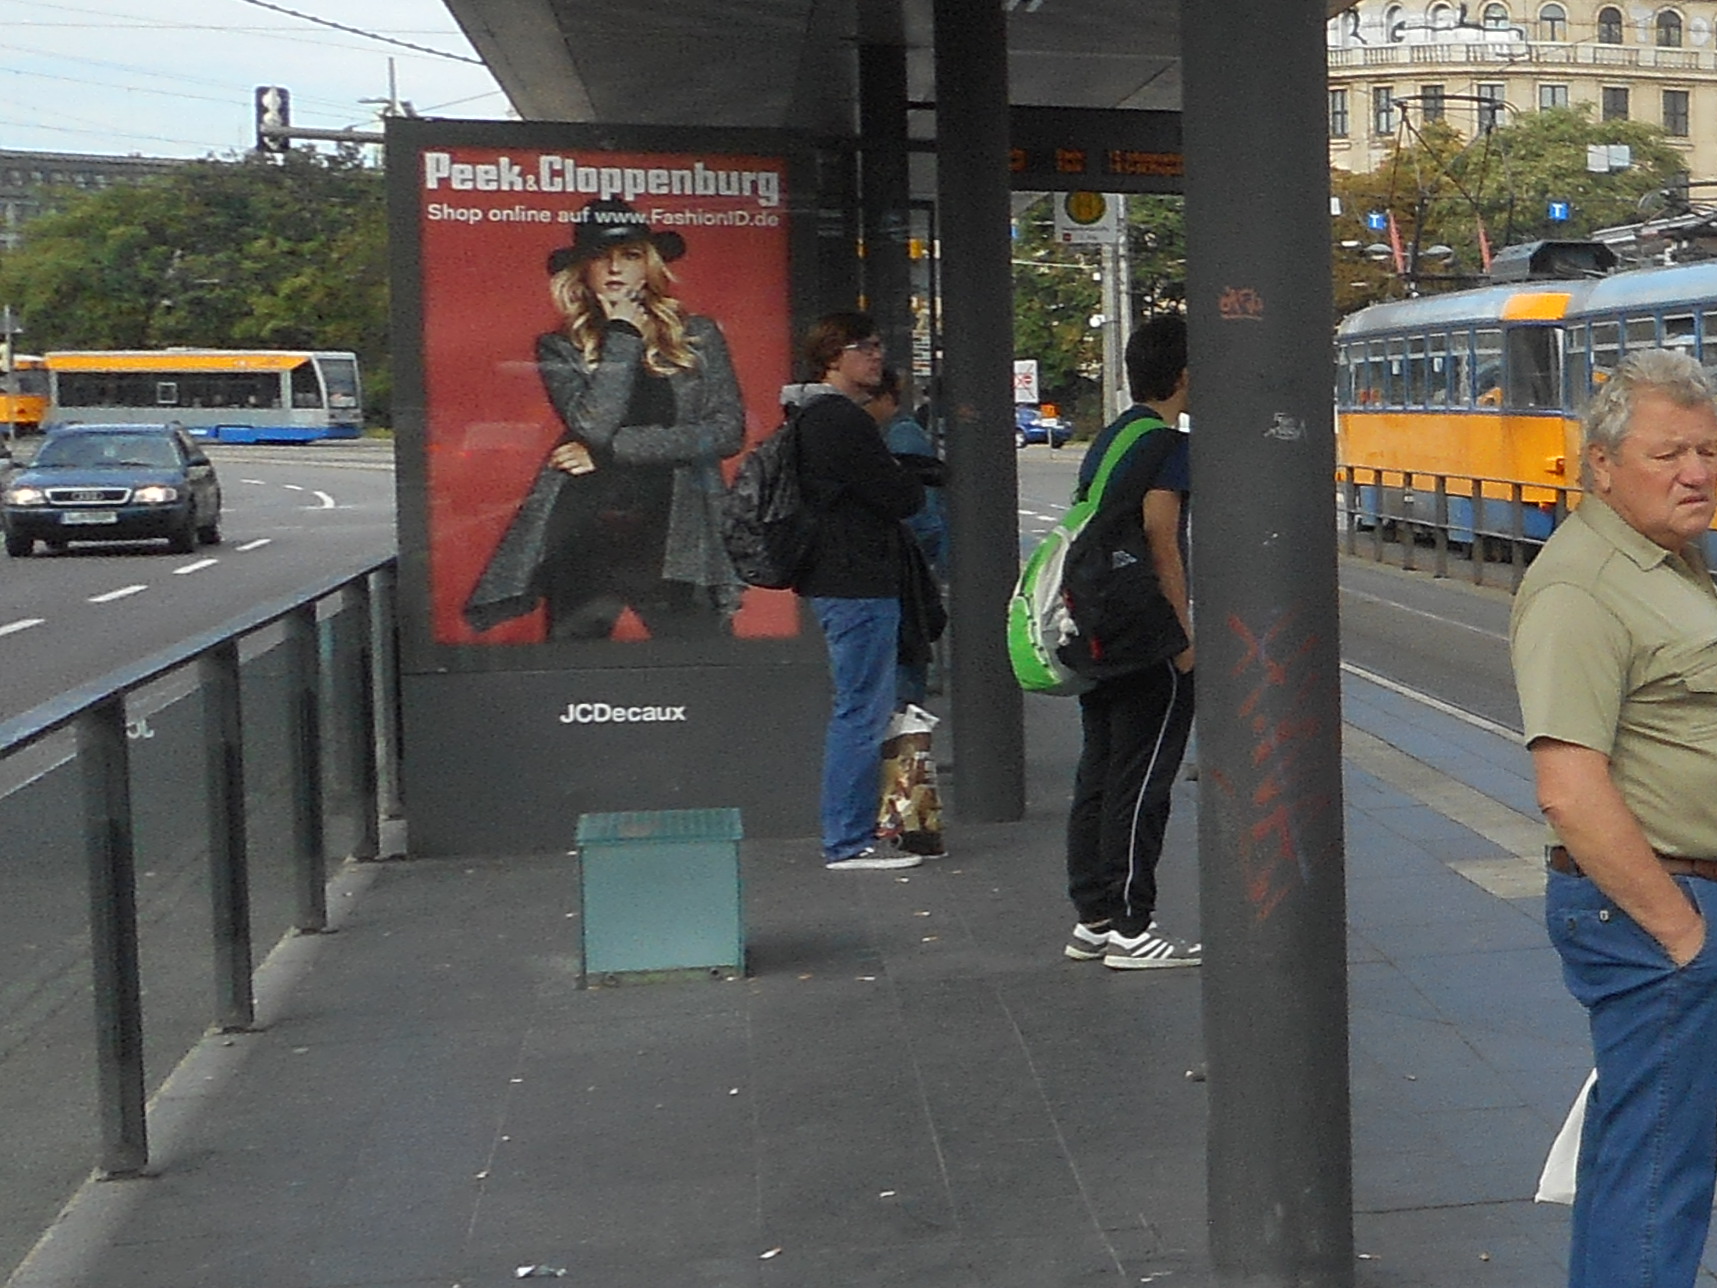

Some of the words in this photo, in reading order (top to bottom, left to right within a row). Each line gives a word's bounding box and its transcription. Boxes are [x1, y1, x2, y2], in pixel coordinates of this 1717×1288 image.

[427, 203, 483, 224] Shop
[488, 204, 551, 223] online
[557, 207, 592, 224] auf
[594, 208, 780, 228] www.FashionID.de
[559, 703, 687, 723] JCDecaux
